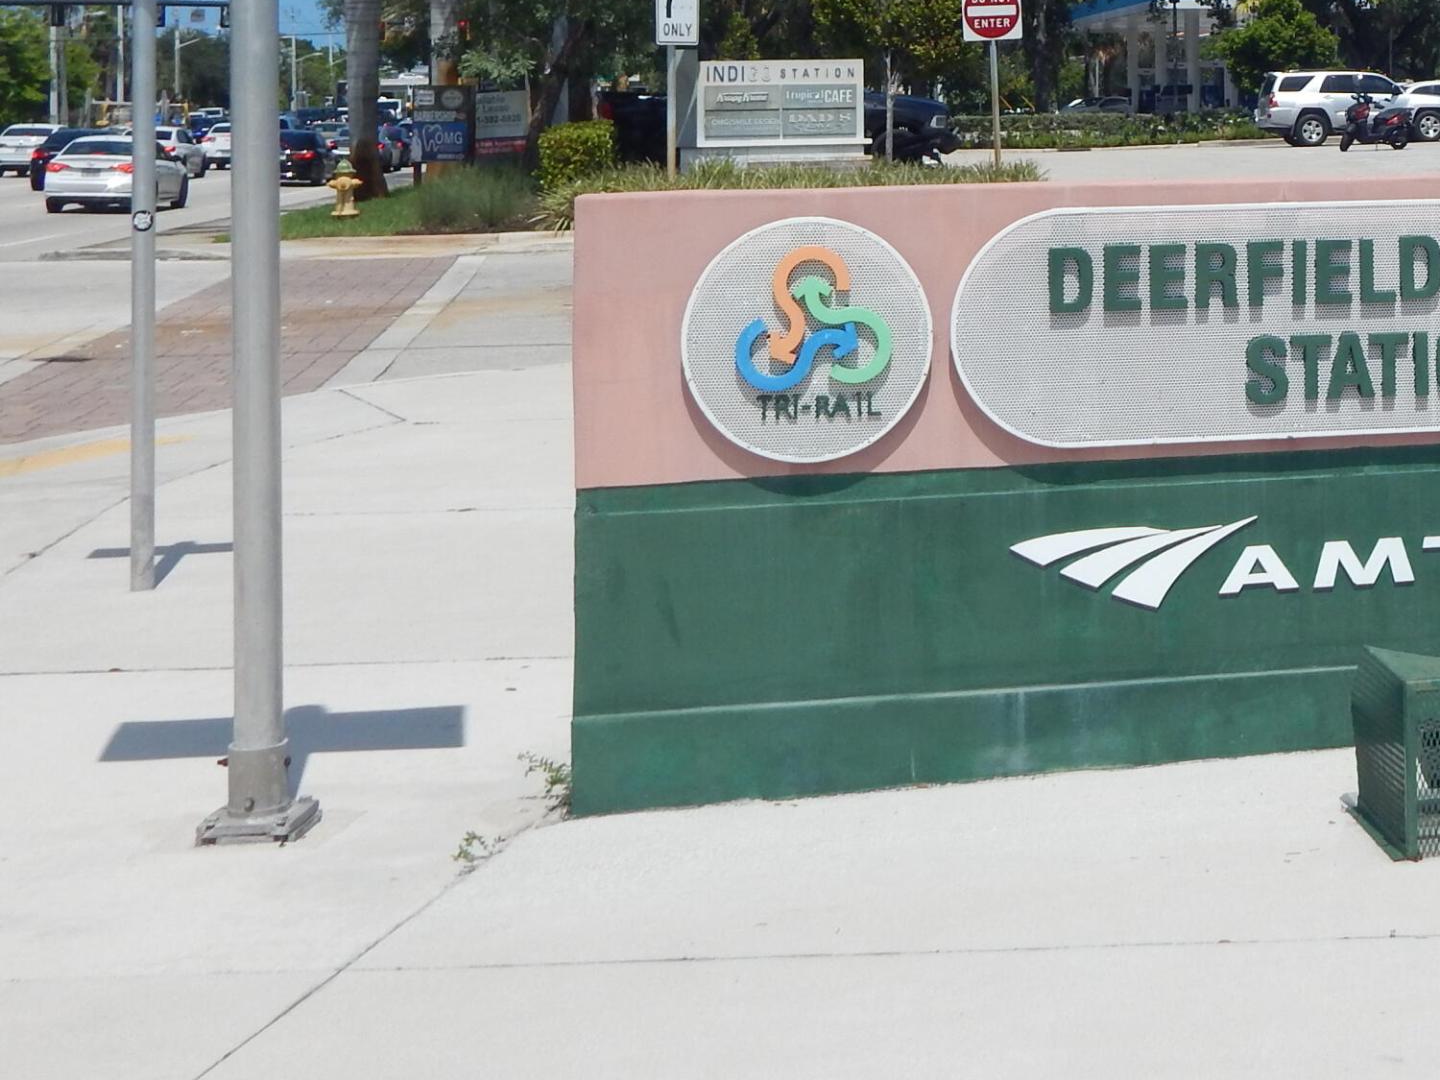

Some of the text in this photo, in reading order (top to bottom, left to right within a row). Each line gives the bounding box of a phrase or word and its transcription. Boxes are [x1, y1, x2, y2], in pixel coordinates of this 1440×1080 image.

[974, 18, 1010, 28] ENTER
[663, 23, 693, 38] ONLY
[780, 68, 855, 79] STATION
[825, 89, 853, 103] CAFE
[435, 131, 463, 144] OMG
[756, 391, 882, 421] TRI-RAIL
